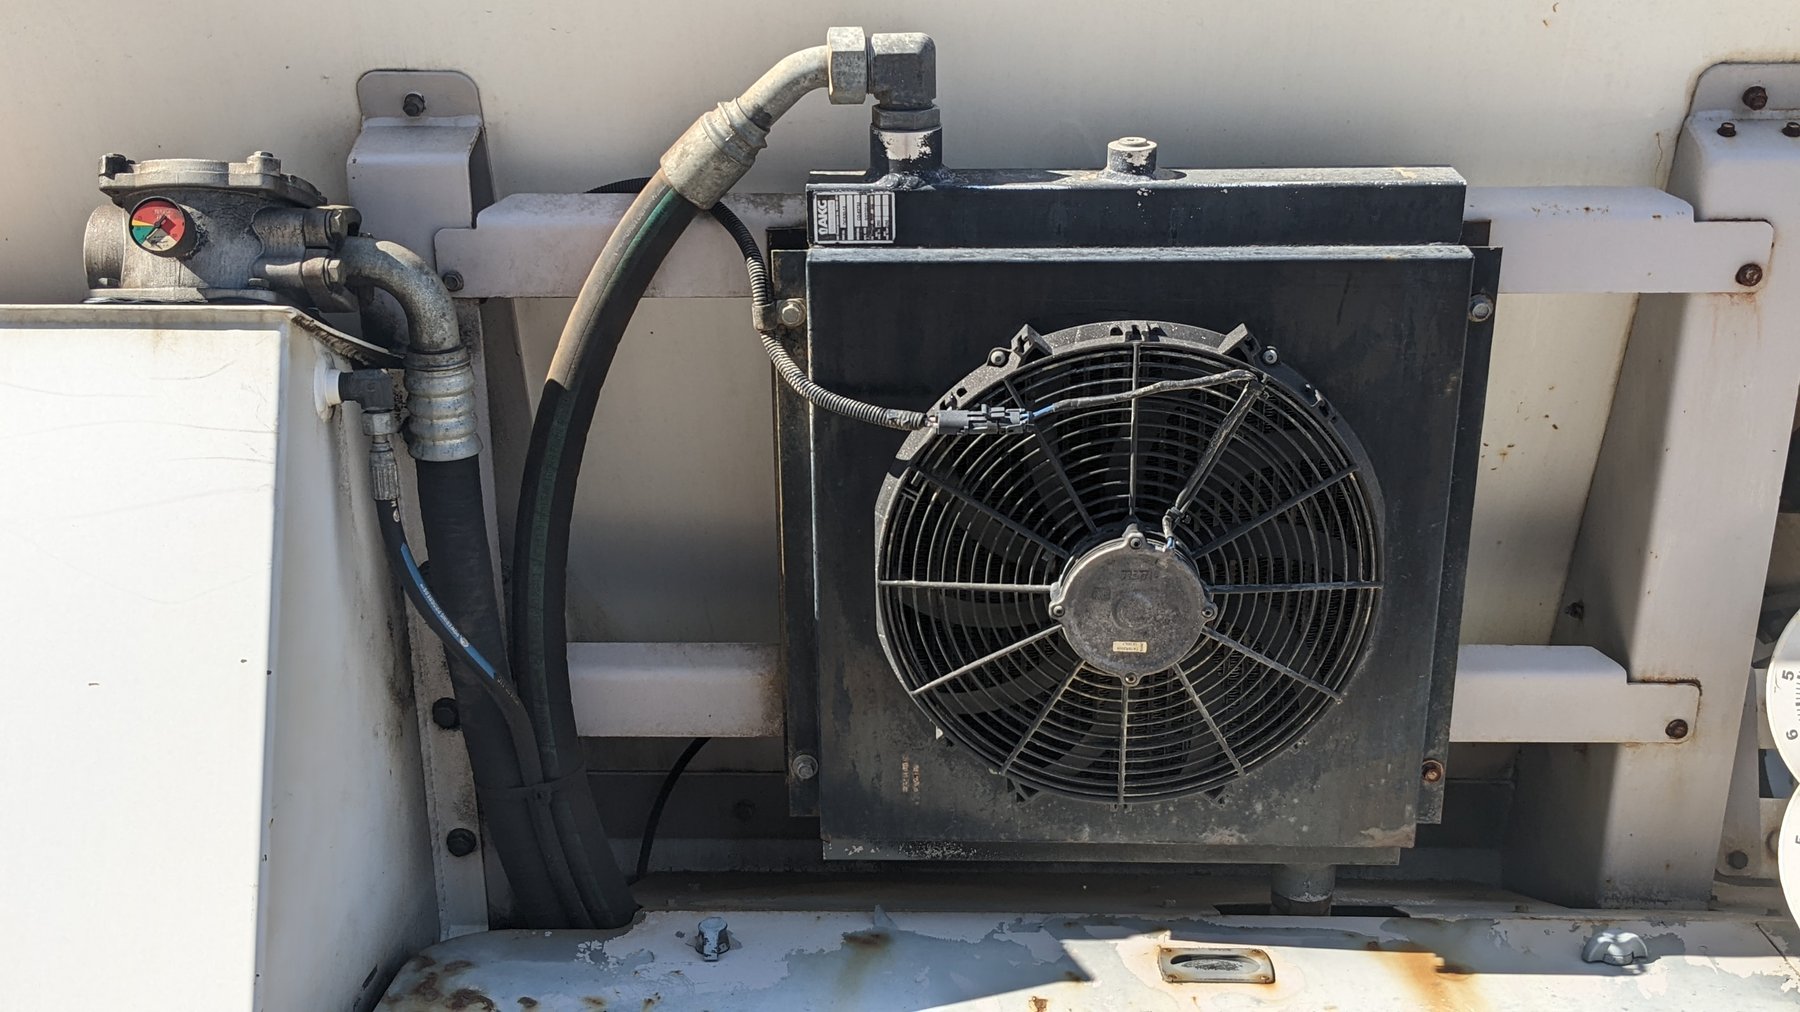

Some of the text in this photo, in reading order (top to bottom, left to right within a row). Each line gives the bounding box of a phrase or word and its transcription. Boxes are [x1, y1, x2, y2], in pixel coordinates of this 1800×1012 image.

[817, 200, 828, 226] AKG
[1781, 670, 1794, 681] 5
[1786, 729, 1798, 740] 6
